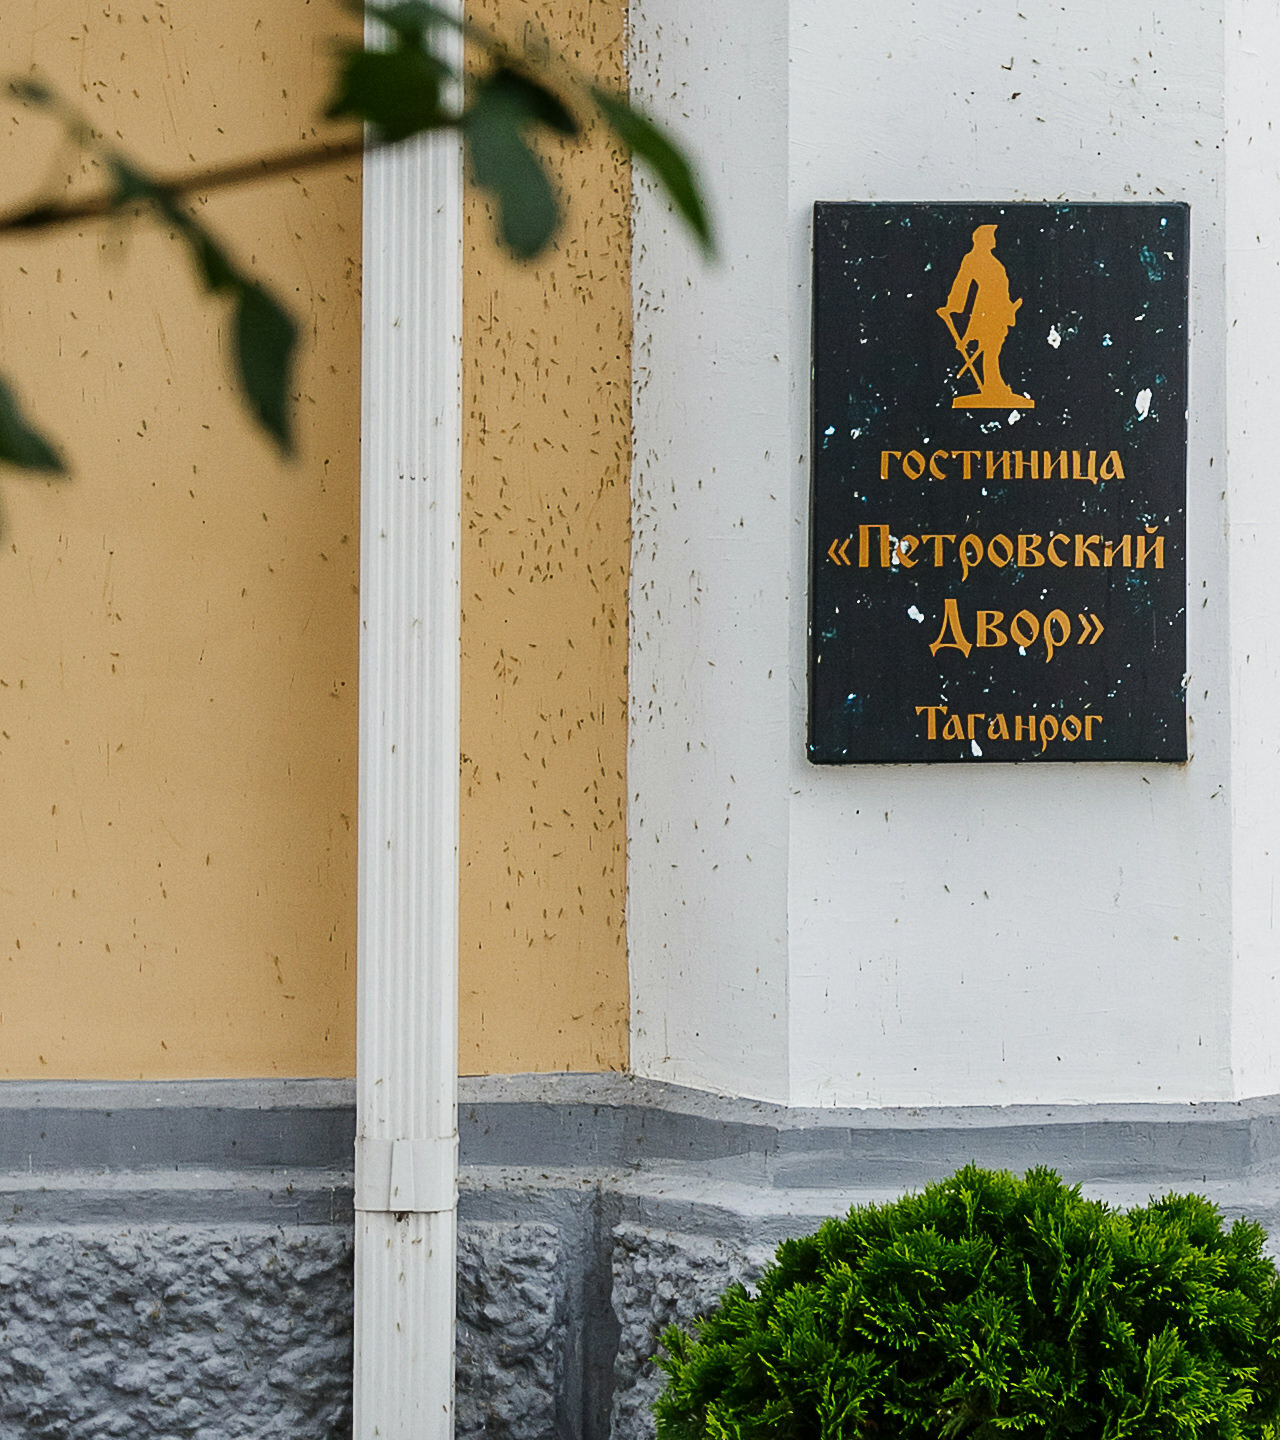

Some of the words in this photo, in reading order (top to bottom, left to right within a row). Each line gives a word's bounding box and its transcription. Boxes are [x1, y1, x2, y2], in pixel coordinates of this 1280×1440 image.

[879, 449, 1126, 484] гостиница
[826, 523, 1165, 583] «Петровский
[928, 597, 1105, 663] Двор»
[915, 705, 1103, 752] Таганрог
